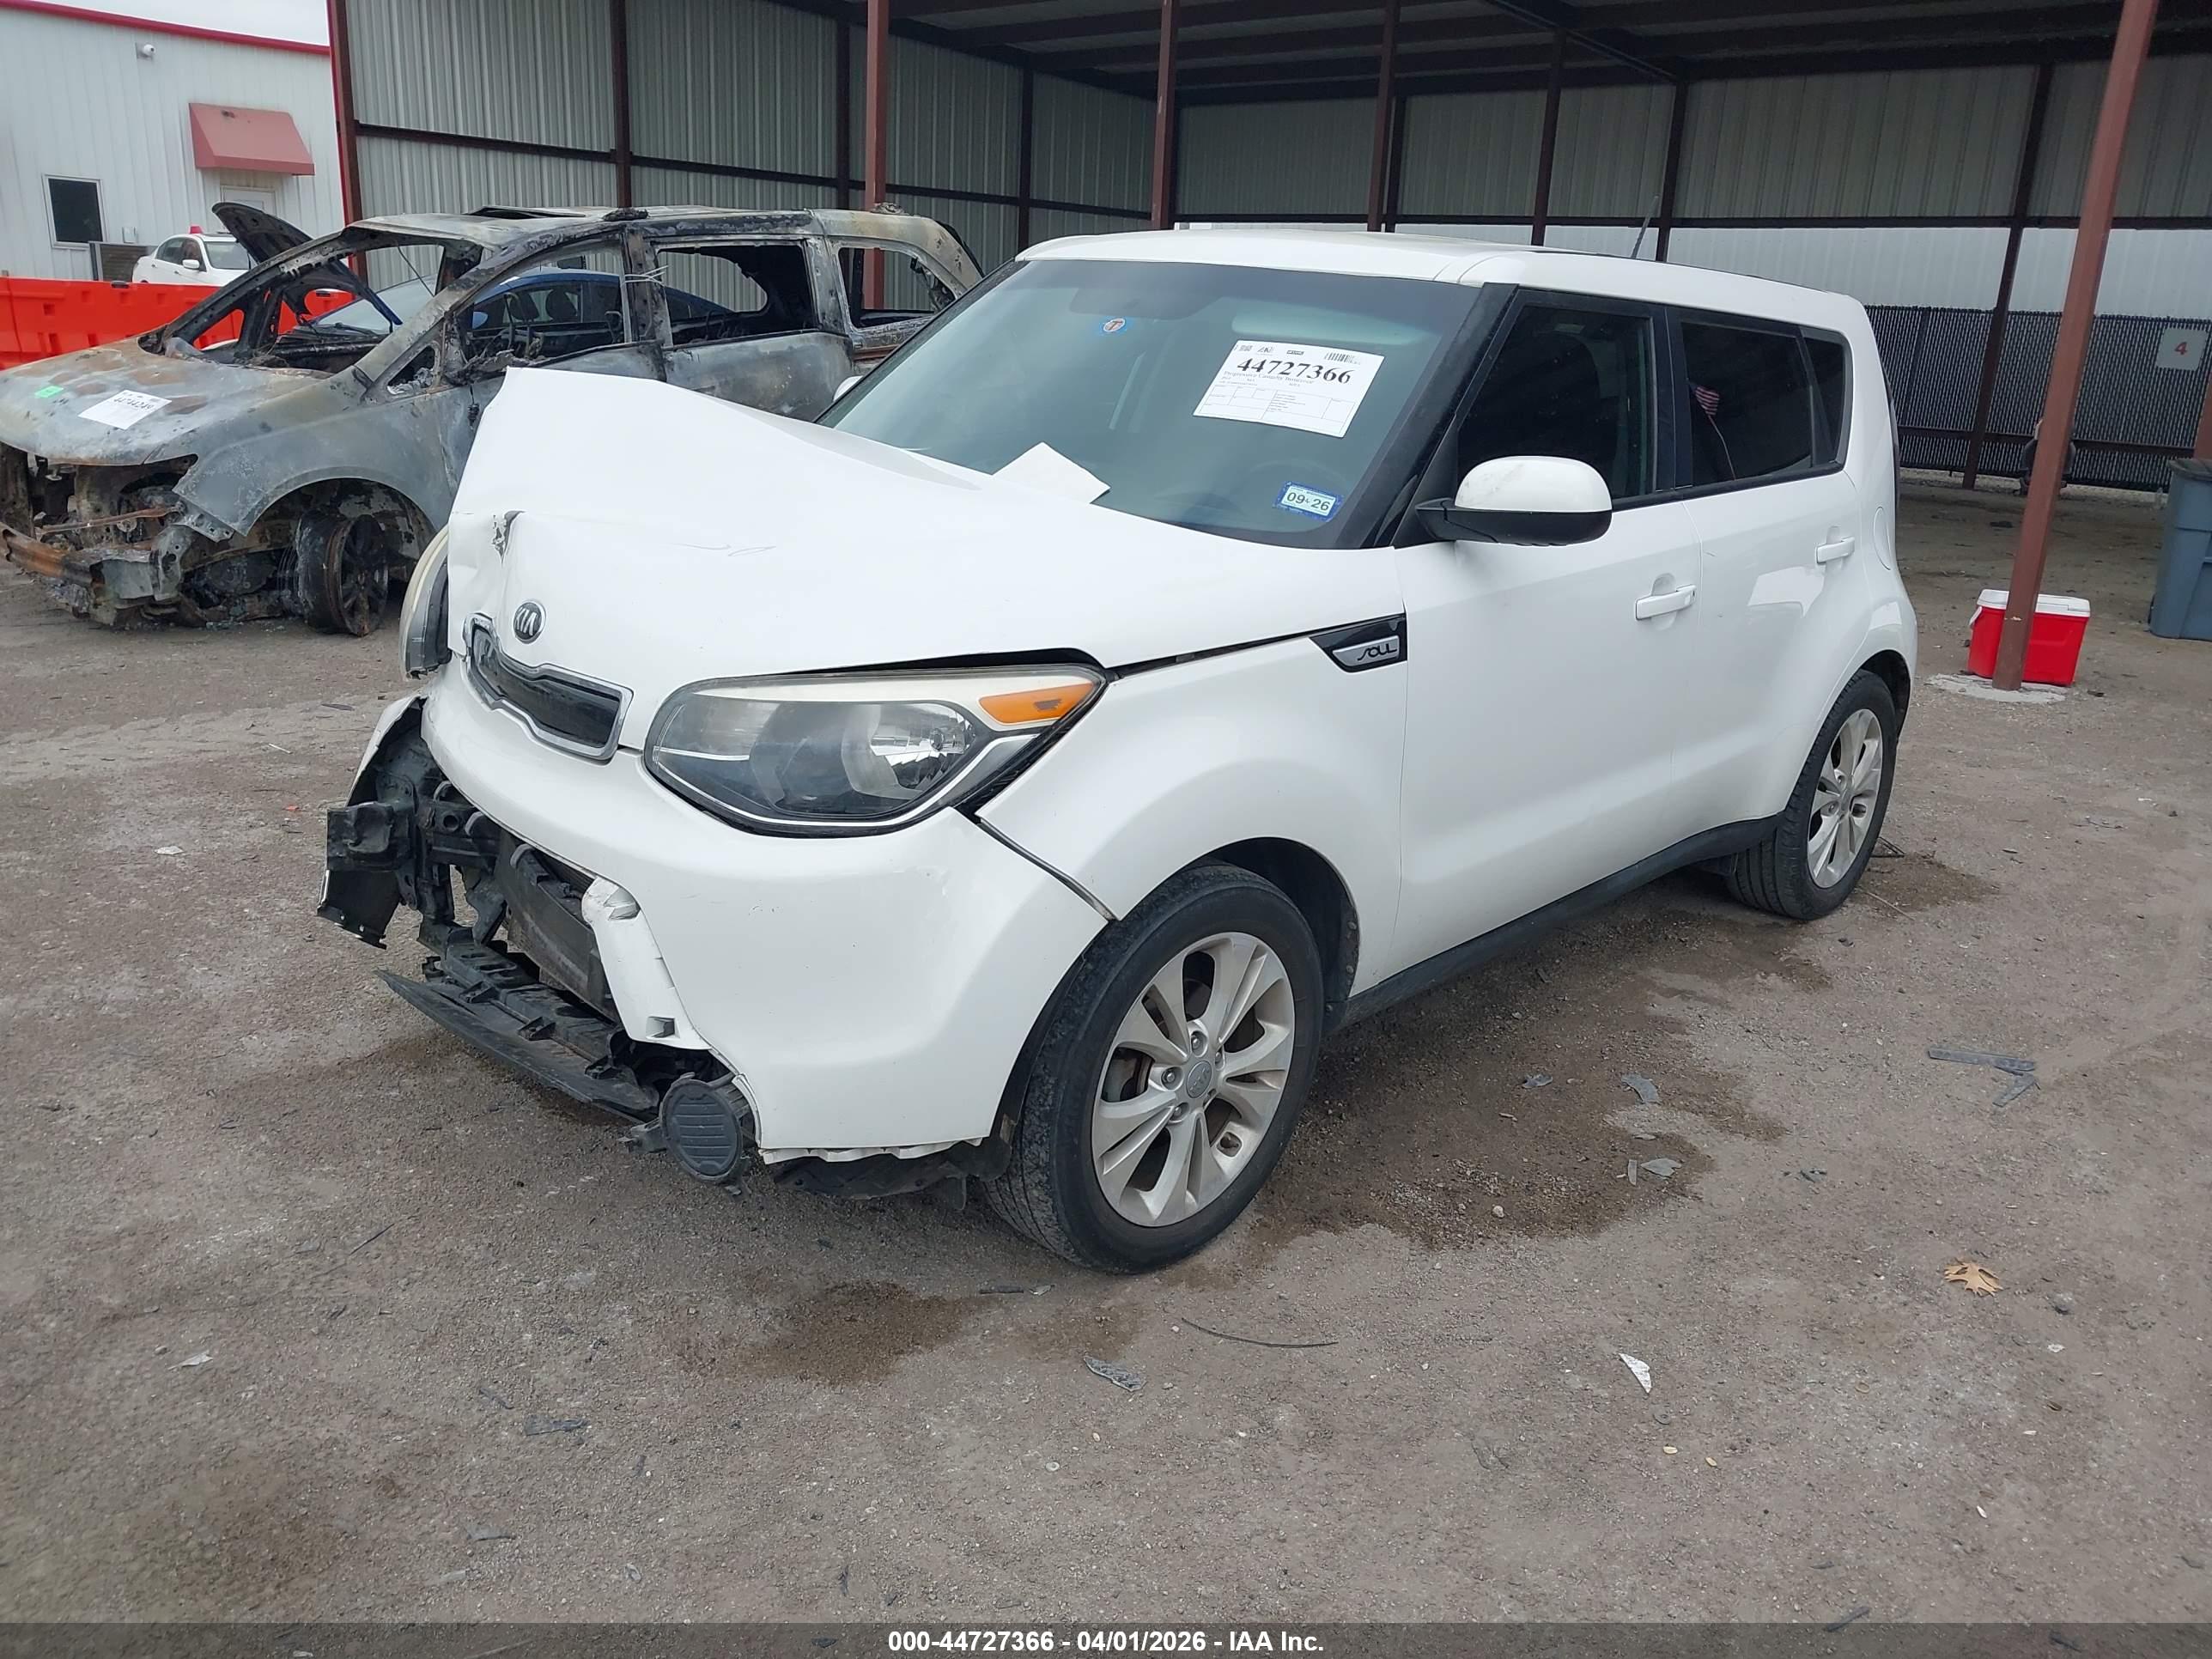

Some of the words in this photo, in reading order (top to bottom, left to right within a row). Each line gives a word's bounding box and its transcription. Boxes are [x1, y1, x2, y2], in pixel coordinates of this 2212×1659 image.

[2174, 341, 2188, 356] 4
[1237, 357, 1355, 385] 44727366
[1286, 492, 1306, 504] 09
[1310, 498, 1331, 511] 26
